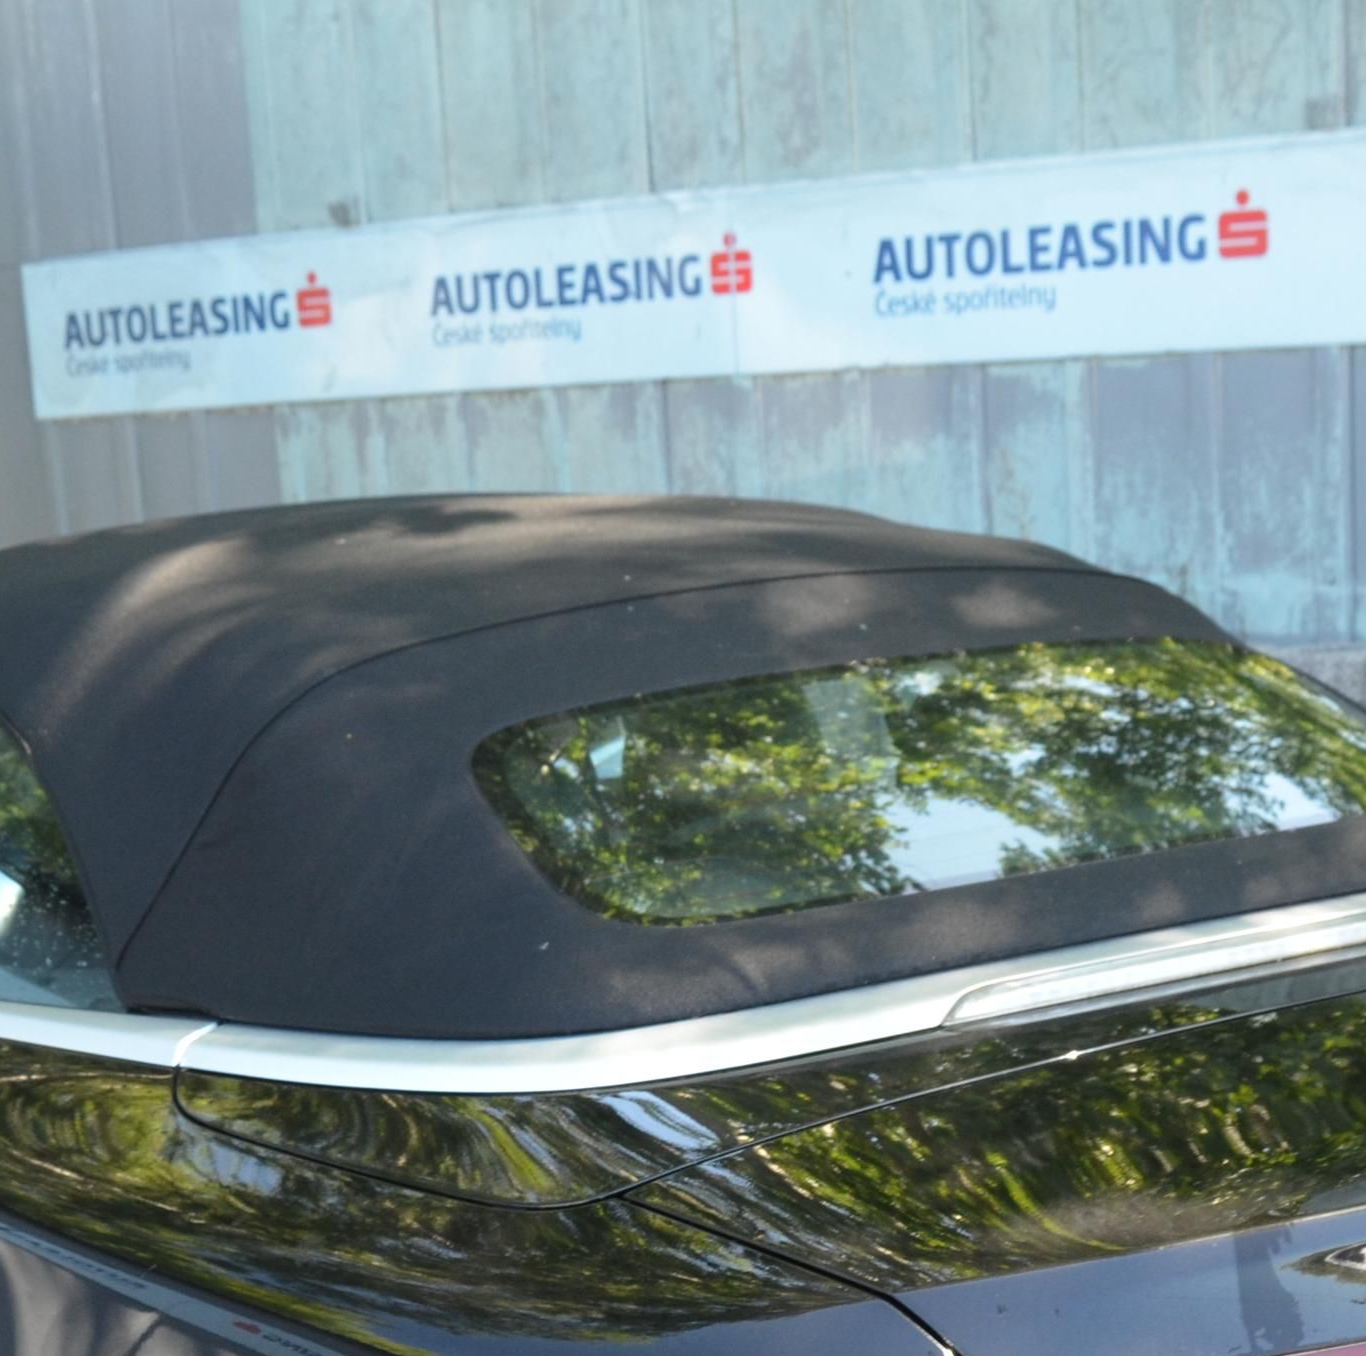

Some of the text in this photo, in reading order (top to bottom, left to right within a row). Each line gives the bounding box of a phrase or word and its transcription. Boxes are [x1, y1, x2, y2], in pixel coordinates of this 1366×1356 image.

[873, 214, 1207, 284] AUTOLEASING
[431, 255, 702, 316] AUTOLEASING
[874, 287, 938, 318] České
[65, 290, 290, 350] AUTOLEASING
